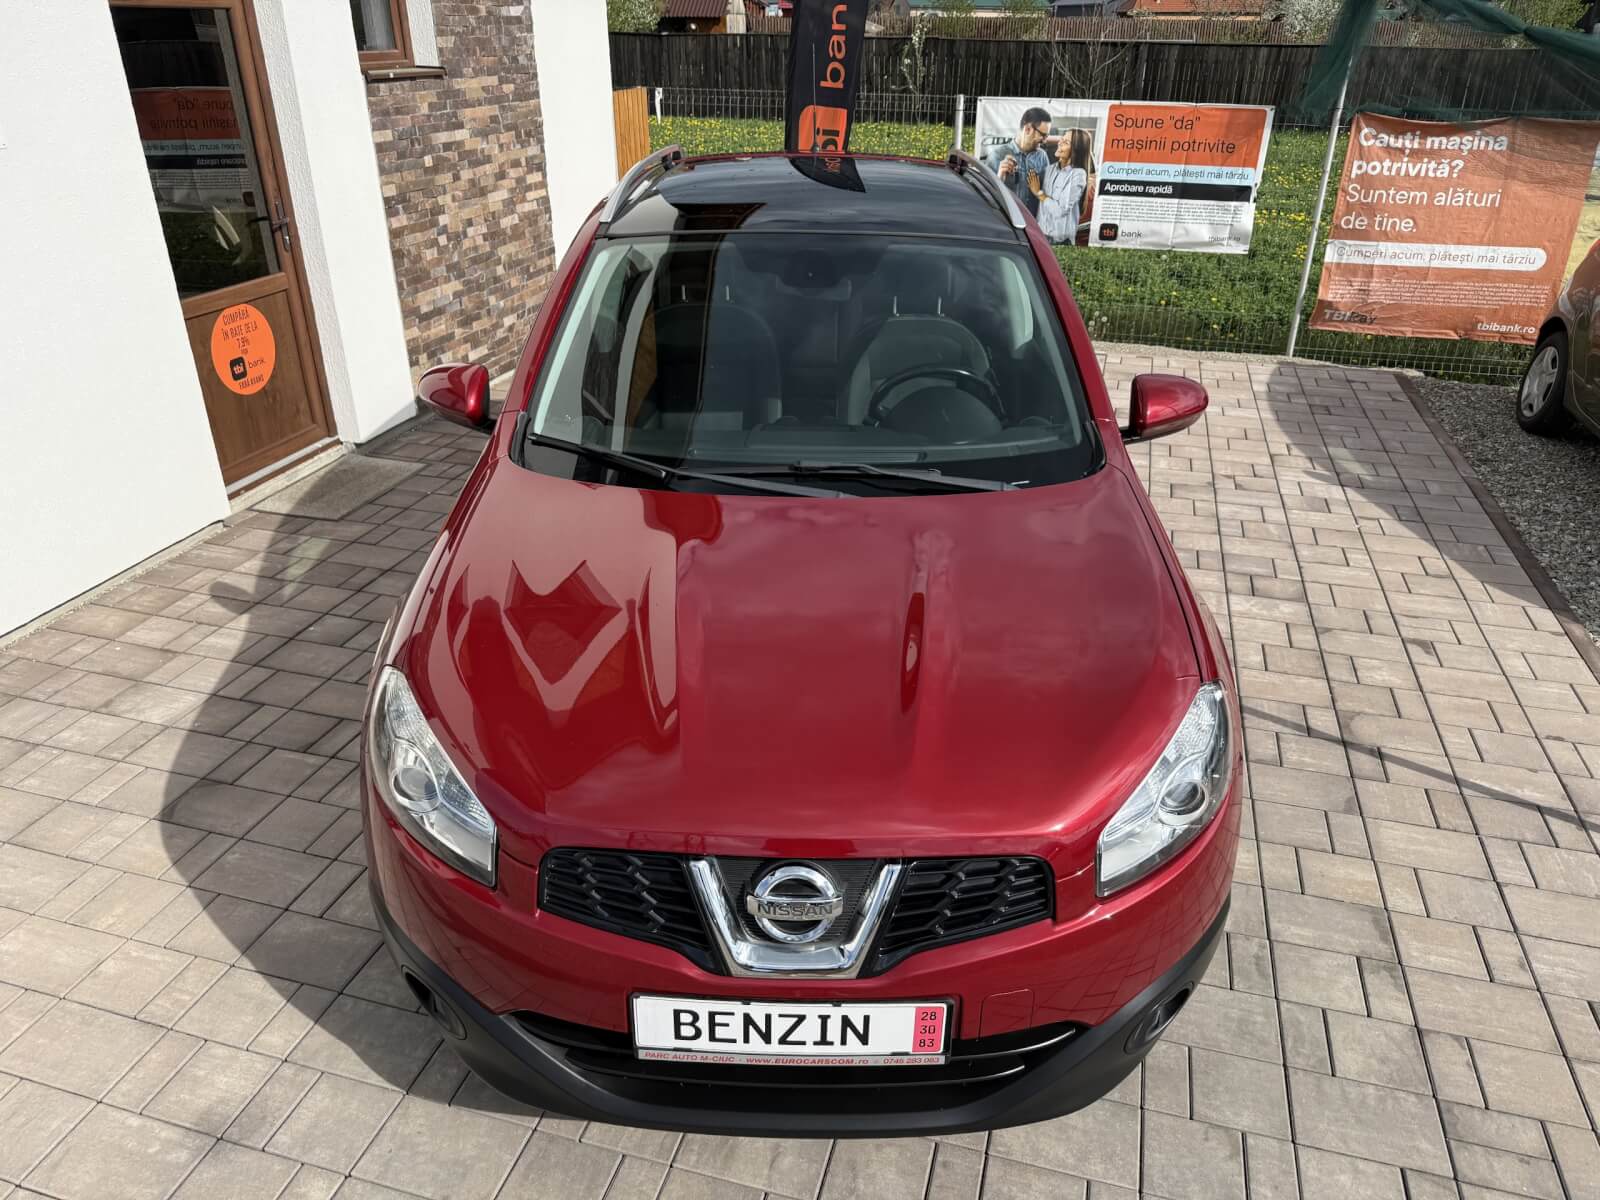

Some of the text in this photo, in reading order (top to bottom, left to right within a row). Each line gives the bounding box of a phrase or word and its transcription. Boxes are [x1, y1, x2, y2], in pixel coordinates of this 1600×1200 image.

[1113, 113, 1201, 132] Spune "da"
[1110, 136, 1236, 154] mașinii potrivite
[1358, 127, 1422, 157] Cauți
[1107, 165, 1143, 179] Cumperi
[1145, 168, 1171, 179] acum,
[1206, 170, 1223, 179] mai
[1225, 171, 1249, 181] târziu
[1350, 158, 1465, 179] potrivită?
[1104, 182, 1173, 196] Aprobare rapidă
[1346, 183, 1503, 208] Suntem alături
[1340, 211, 1368, 230] de
[1102, 228, 1143, 239] tbi bank
[1336, 246, 1387, 262] Cumperi
[1390, 249, 1427, 262] acum,
[1476, 252, 1499, 264] mai
[1502, 253, 1537, 266] târziu
[1477, 321, 1537, 336] tbibank.ro
[248, 357, 266, 369] bank
[757, 901, 833, 916] NISSAN
[920, 1011, 937, 1021] 28
[673, 1008, 870, 1046] BENZIN
[919, 1025, 936, 1034] 30
[918, 1038, 935, 1048] 83
[671, 1053, 698, 1062] AUTO
